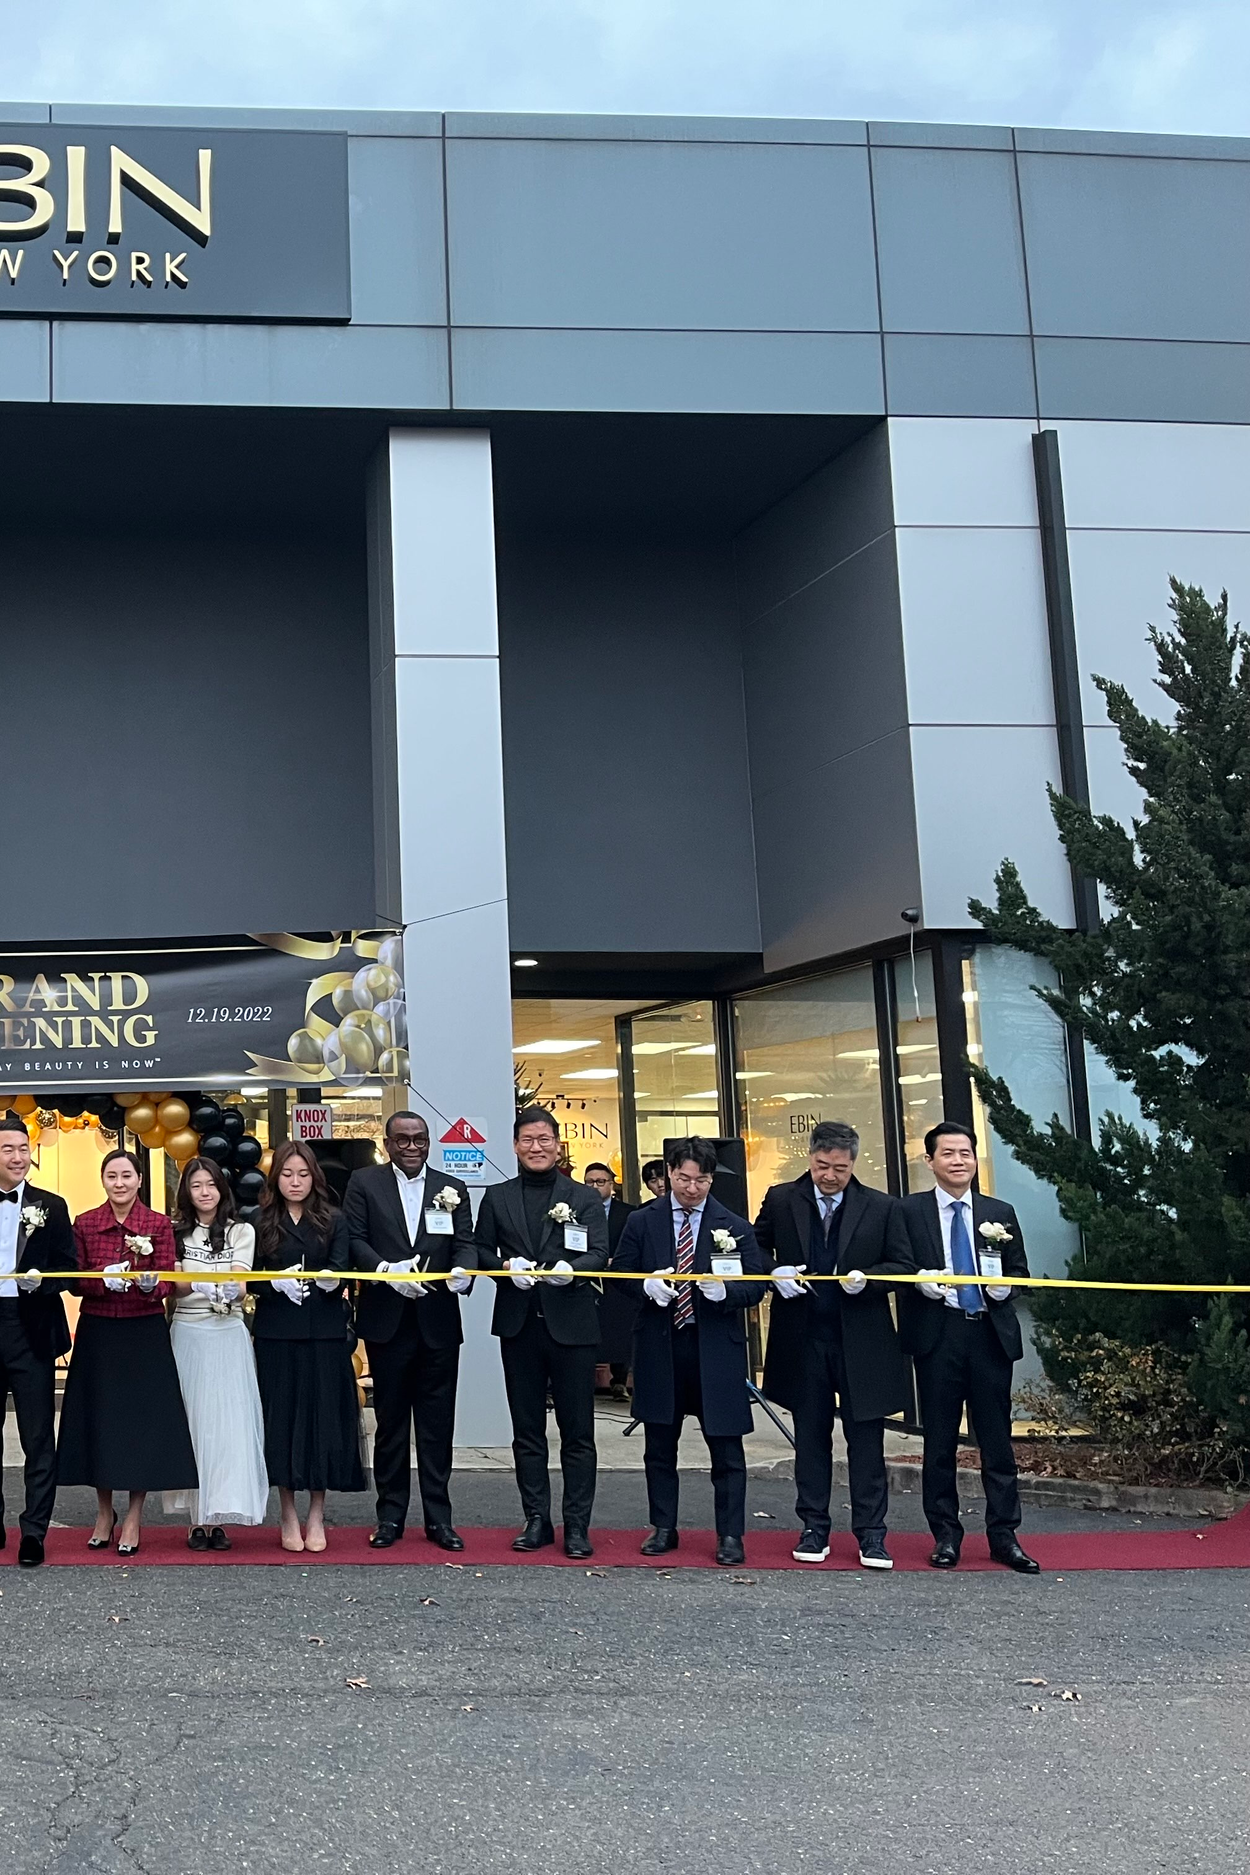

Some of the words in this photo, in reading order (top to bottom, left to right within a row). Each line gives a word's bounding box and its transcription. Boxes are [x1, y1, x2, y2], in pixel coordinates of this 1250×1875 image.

[52, 249, 189, 286] YORK
[186, 1006, 273, 1023] 12.19.2022
[24, 1061, 84, 1071] BEAUTY
[95, 1060, 110, 1069] IS
[295, 1109, 328, 1123] KNOX
[300, 1125, 324, 1139] BOX
[559, 1122, 608, 1139] BIN
[445, 1151, 483, 1161] NOTICE
